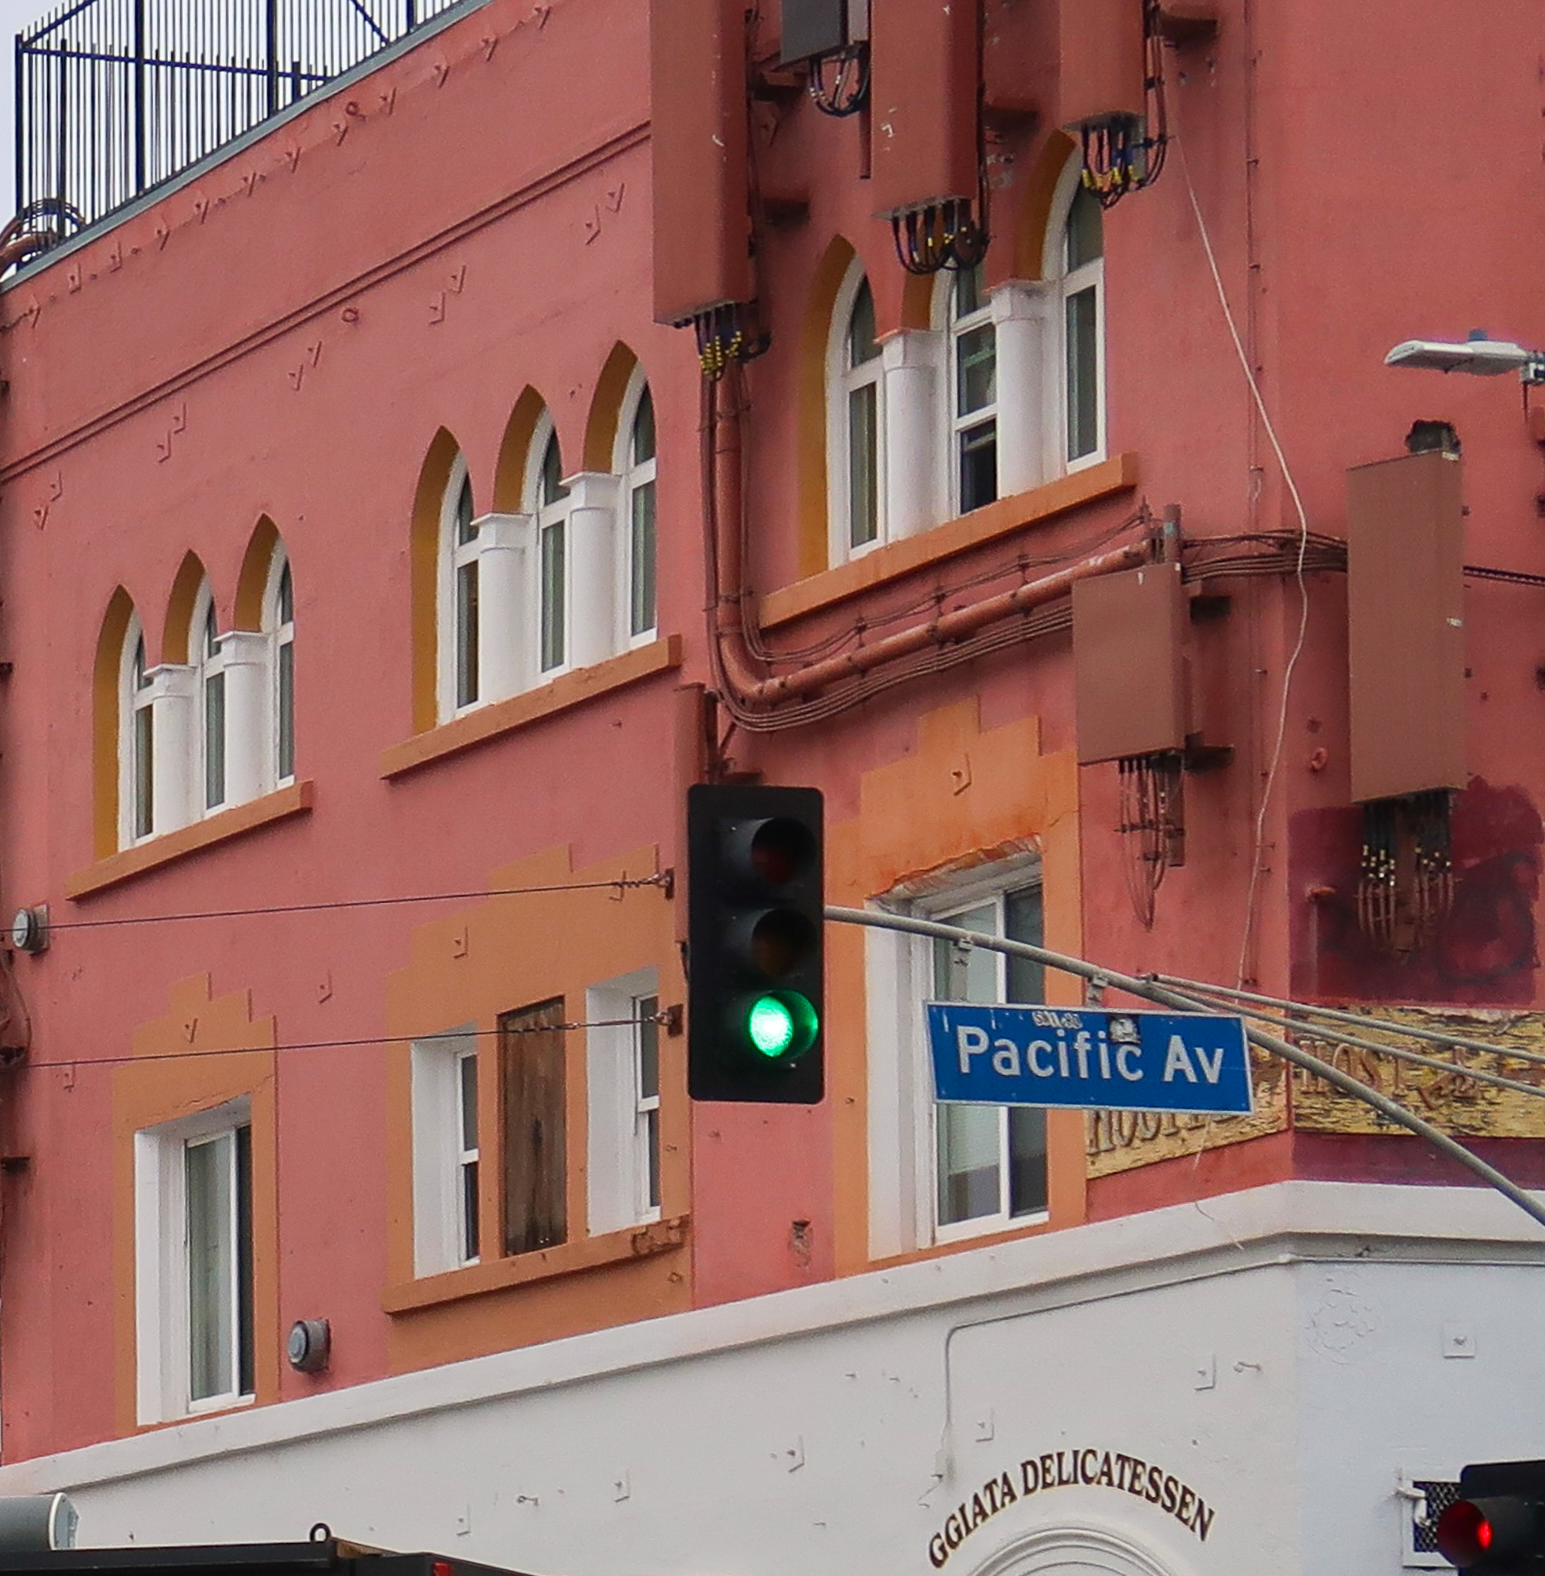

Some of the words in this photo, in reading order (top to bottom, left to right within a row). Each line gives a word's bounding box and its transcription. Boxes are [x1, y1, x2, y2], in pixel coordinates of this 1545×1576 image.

[957, 1024, 1144, 1081] Pacific
[1162, 1035, 1224, 1083] Av
[928, 1471, 1018, 1568] GGIATA
[1020, 1449, 1216, 1542] DELICATESSEN
